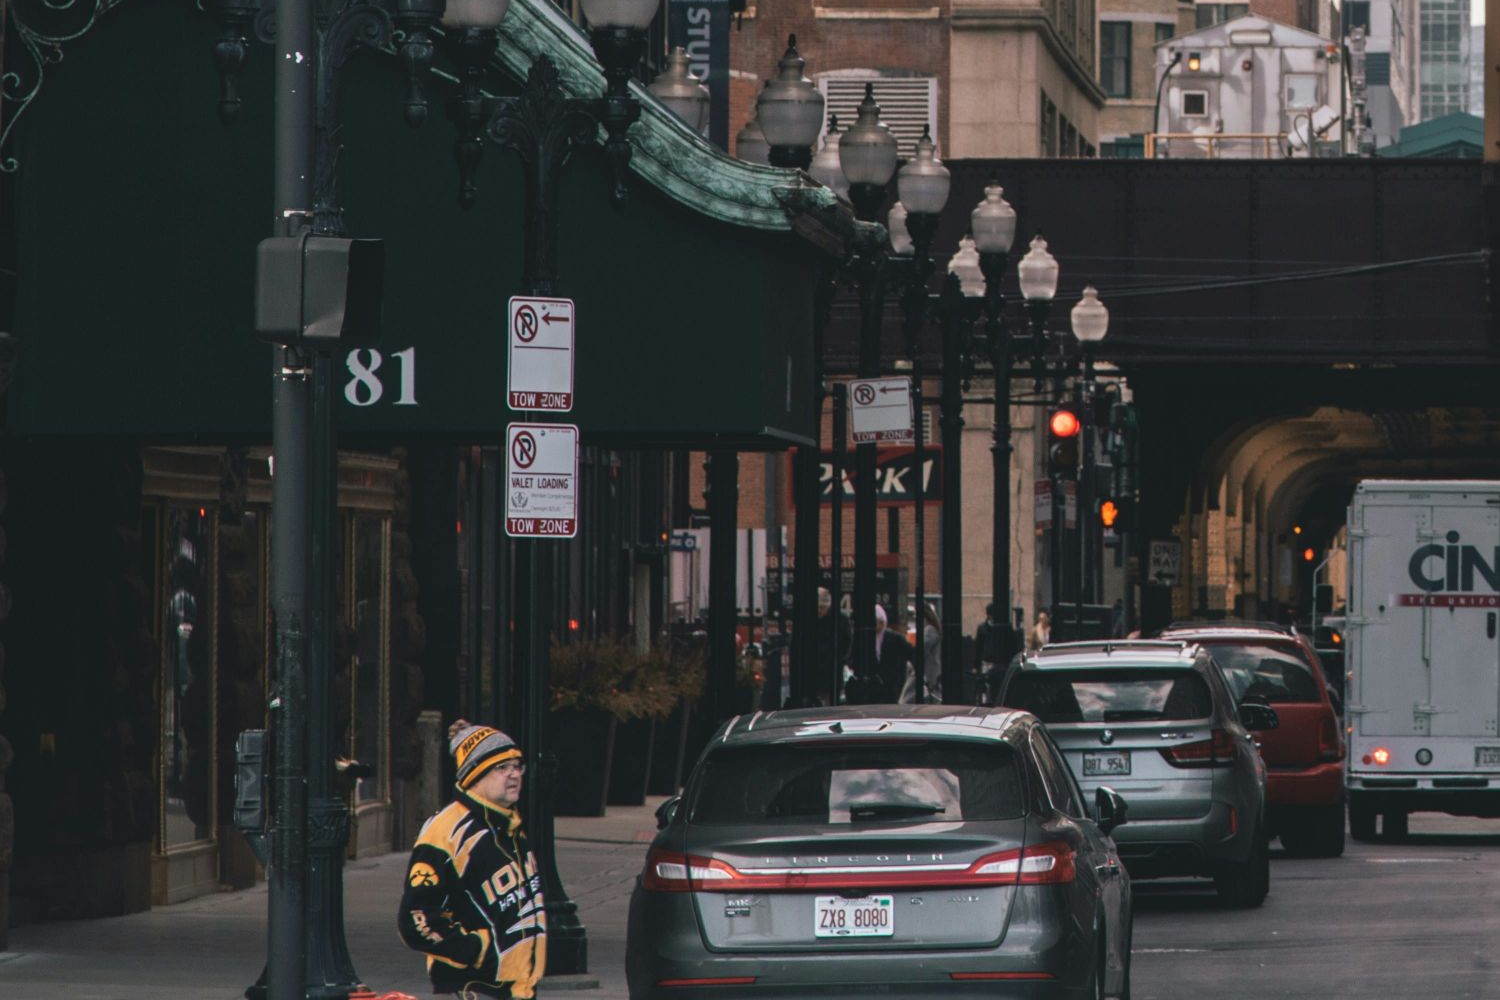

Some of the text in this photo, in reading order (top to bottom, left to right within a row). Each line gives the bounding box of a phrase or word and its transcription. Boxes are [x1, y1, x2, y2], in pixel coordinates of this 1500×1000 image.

[687, 7, 711, 83] STUD
[344, 346, 419, 407] 81
[513, 392, 568, 408] TOW ZONE
[856, 430, 909, 441] TOW ZONE
[511, 477, 569, 490] VALET LOADING
[511, 519, 570, 534] TOW ZONE
[1153, 544, 1178, 556] ONE
[1152, 556, 1179, 569] WAY
[1408, 596, 1436, 605] THE
[765, 853, 945, 864] LINCOLN
[820, 907, 888, 928] ZX8 8080
